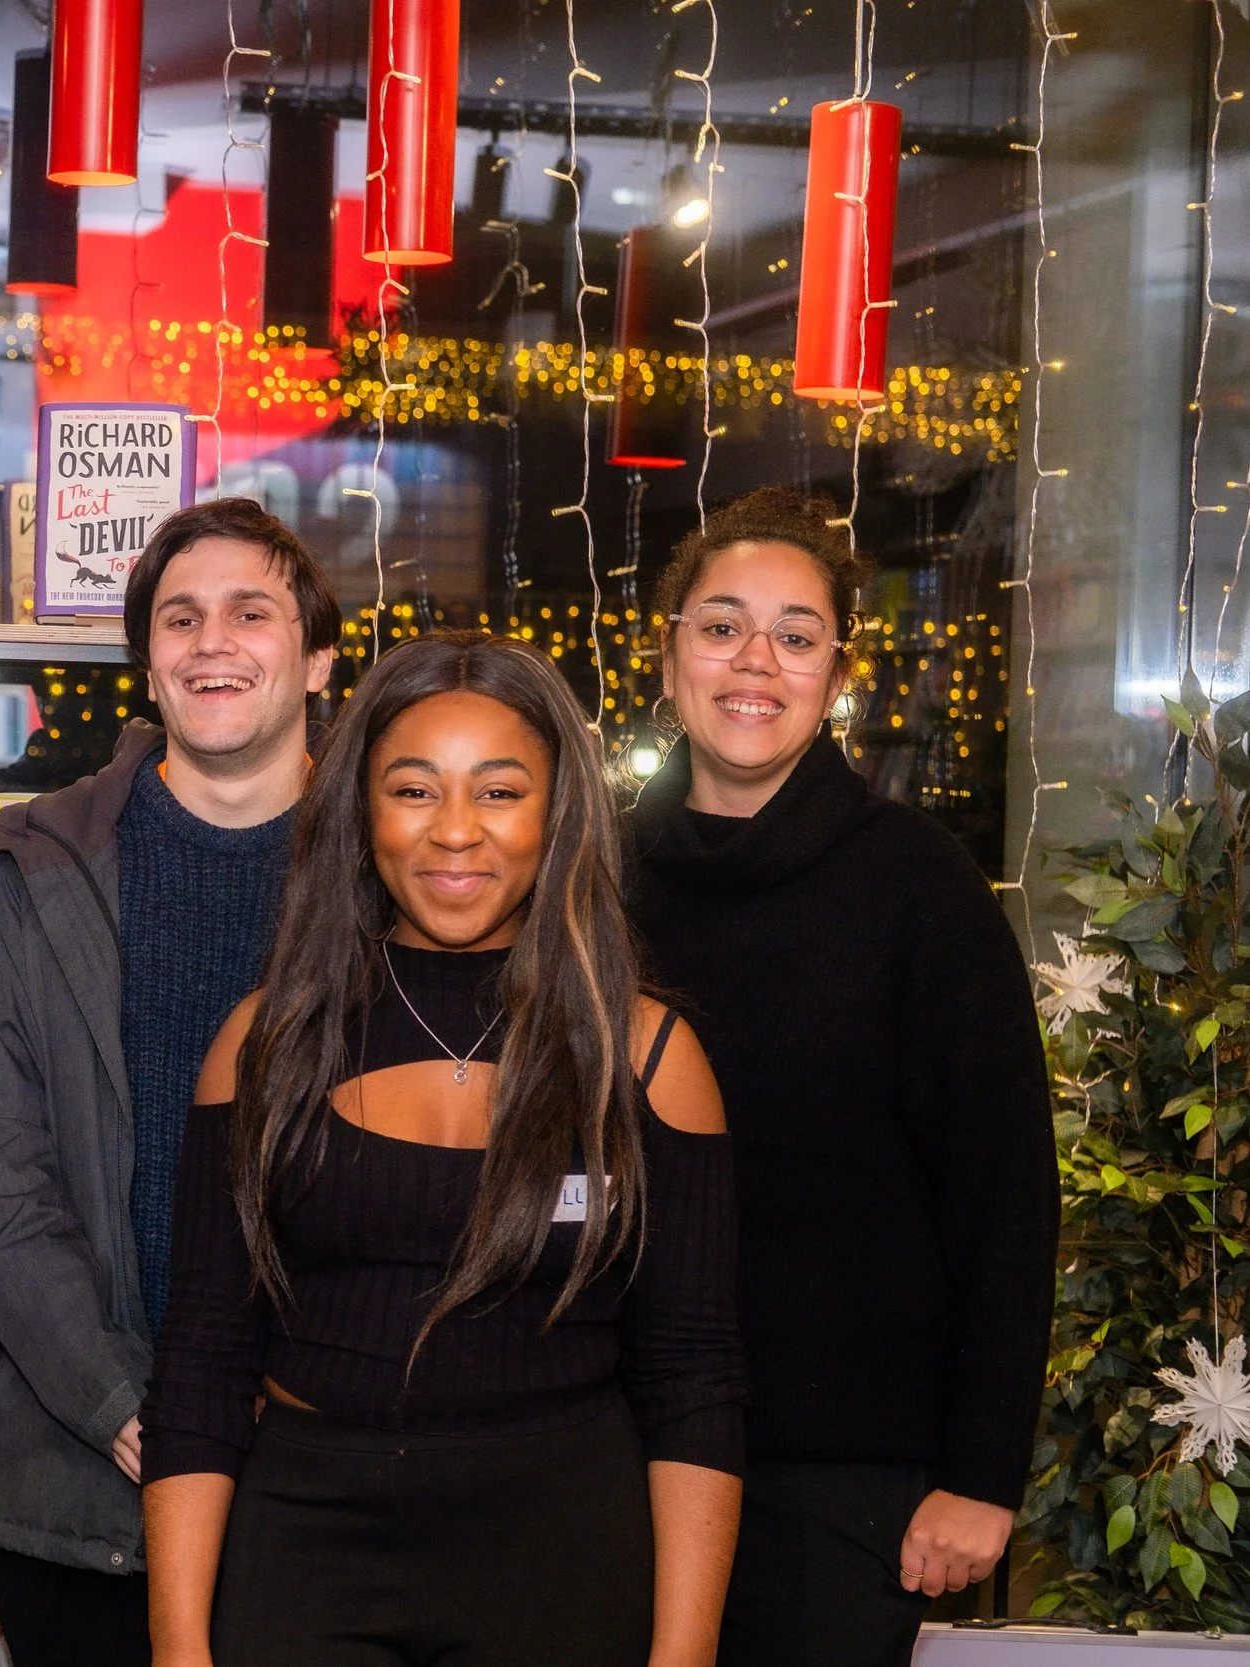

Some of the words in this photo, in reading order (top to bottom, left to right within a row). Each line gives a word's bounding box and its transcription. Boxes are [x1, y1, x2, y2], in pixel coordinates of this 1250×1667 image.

[58, 451, 170, 478] OSMAN
[67, 484, 93, 499] The
[56, 488, 117, 521] Last
[106, 557, 126, 573] To
[50, 592, 60, 600] THE
[62, 592, 74, 600] NEW
[76, 592, 104, 601] THURSDAY
[106, 593, 125, 602] MURD
[563, 1187, 584, 1206] LL
